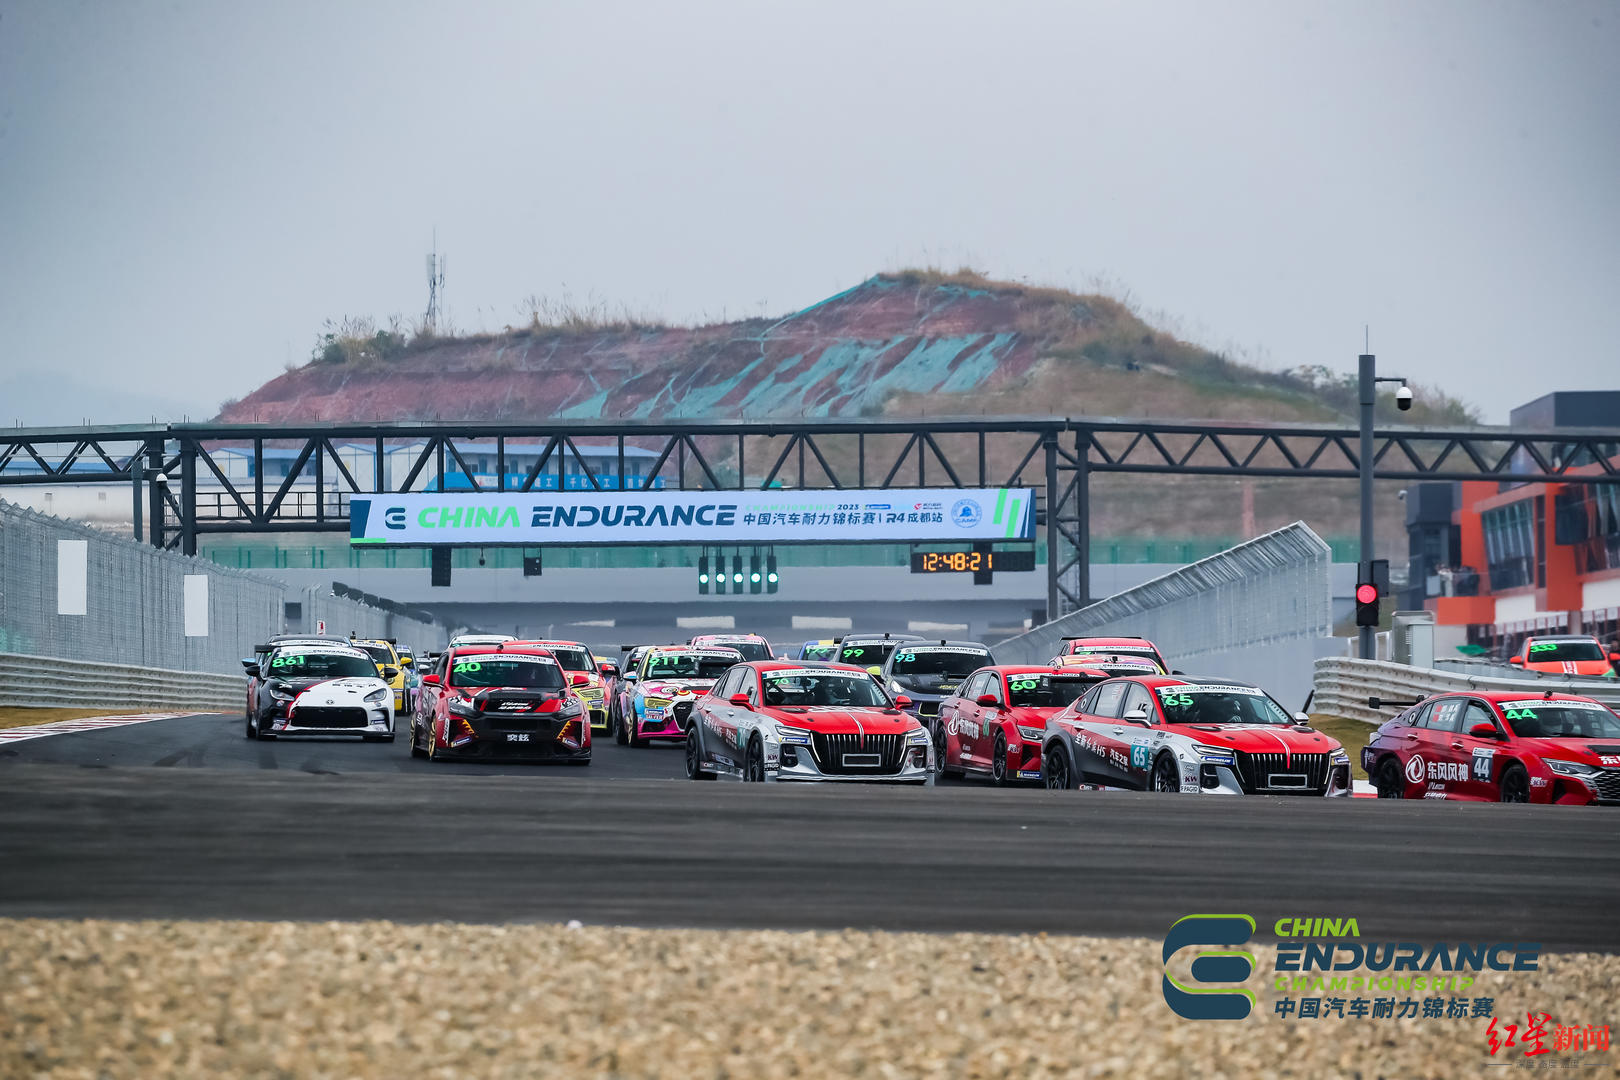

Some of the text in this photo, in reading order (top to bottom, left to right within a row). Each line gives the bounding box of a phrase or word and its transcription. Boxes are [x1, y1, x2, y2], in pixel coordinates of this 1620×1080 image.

[417, 505, 737, 528] CHINA ENDURANCE
[922, 553, 993, 570] 12:48:21
[843, 648, 865, 658] 99
[895, 654, 916, 662] 98
[272, 656, 305, 668] 861
[453, 662, 481, 673] 40
[649, 656, 679, 667] 911
[1010, 680, 1036, 691] 60
[1165, 694, 1194, 706] 65
[1505, 708, 1538, 720] 44
[1133, 746, 1146, 767] 65
[1427, 761, 1469, 782] 东风风神
[1473, 757, 1490, 778] 44
